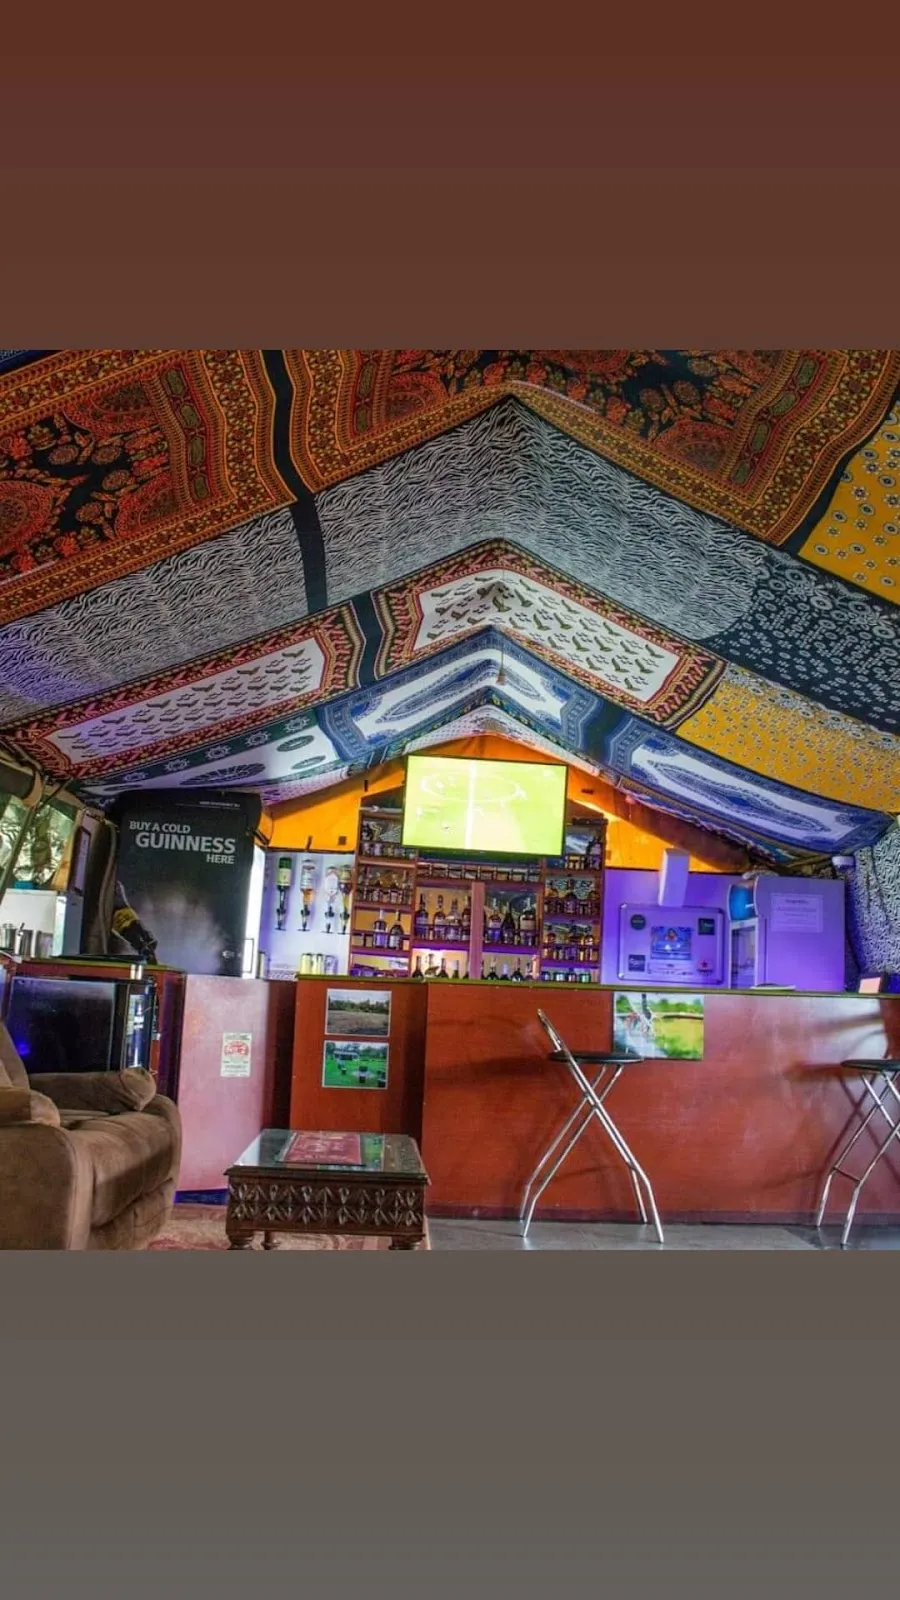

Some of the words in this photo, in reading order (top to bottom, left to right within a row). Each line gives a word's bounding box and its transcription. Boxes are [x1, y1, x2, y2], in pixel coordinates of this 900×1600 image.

[129, 820, 151, 831] BUY
[152, 822, 160, 832] A
[162, 823, 191, 834] COLD
[135, 831, 236, 854] GUINNESS
[206, 853, 235, 865] HERE
